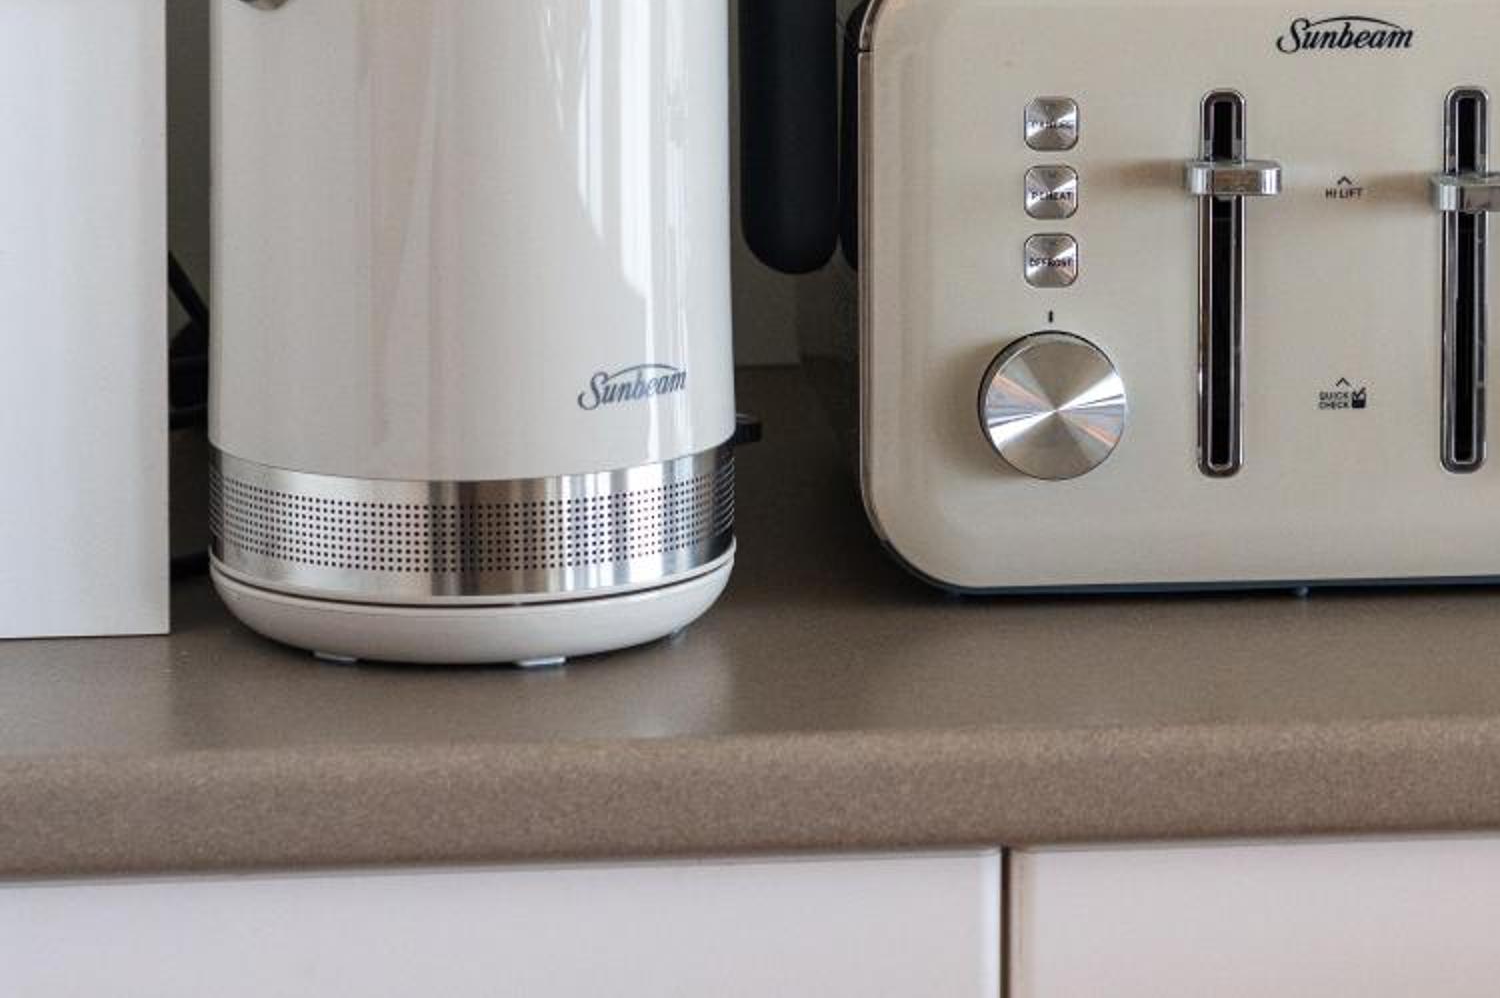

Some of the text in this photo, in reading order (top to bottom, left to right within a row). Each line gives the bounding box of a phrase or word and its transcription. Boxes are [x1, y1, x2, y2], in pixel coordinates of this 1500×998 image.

[1275, 16, 1414, 54] Sunbeam
[1325, 187, 1363, 199] HI LIFT
[577, 363, 687, 411] Sunbeam
